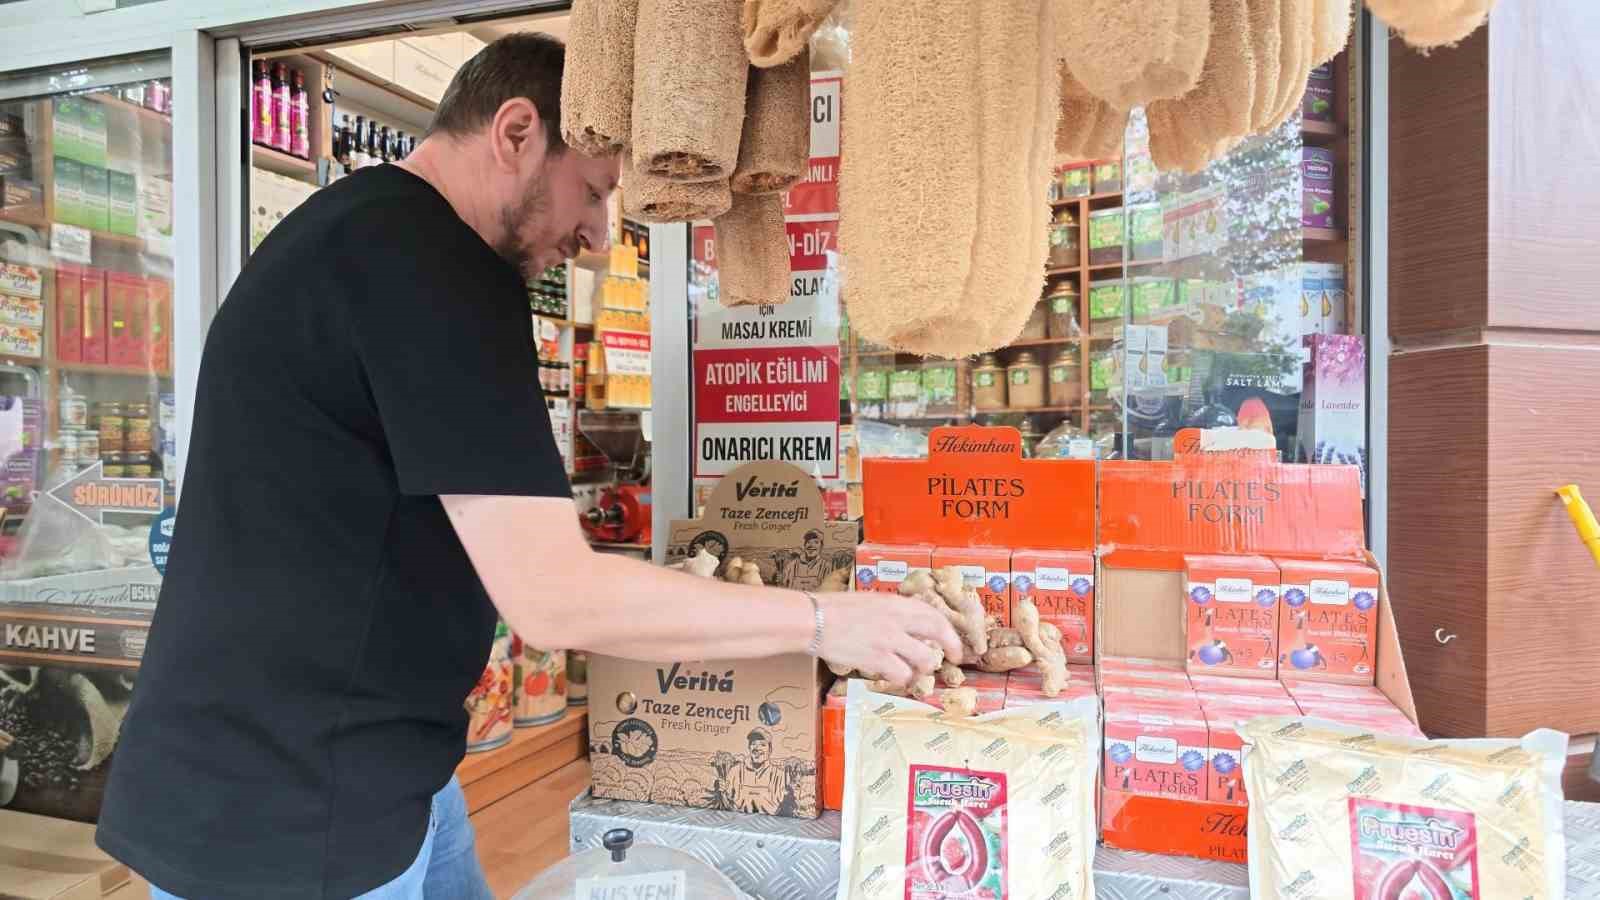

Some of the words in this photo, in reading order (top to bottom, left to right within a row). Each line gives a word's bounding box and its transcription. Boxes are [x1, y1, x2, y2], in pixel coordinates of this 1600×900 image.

[721, 321, 765, 340] MASAJ
[769, 316, 812, 339] KREMİ
[705, 358, 762, 385] ATOPİK
[766, 356, 828, 384] EĞİLİMİ
[1225, 378, 1252, 387] SALT
[725, 390, 808, 413] ENGELLEYİCİ
[1321, 399, 1361, 410] Lavender
[702, 436, 774, 462] ONARICI
[779, 436, 831, 462] KREM
[927, 472, 1025, 497] PİLATES
[720, 507, 752, 520] Taze
[755, 507, 809, 523] Zencefil
[941, 499, 1010, 519] FORM
[1188, 503, 1265, 524] FORM
[733, 521, 759, 530] Fresh
[761, 522, 792, 533] Ginger
[5, 623, 96, 652] KAHVE
[642, 699, 681, 716] Taze
[685, 702, 750, 725] Zencefil
[660, 718, 691, 732] Fresh
[694, 720, 732, 737] Ginger
